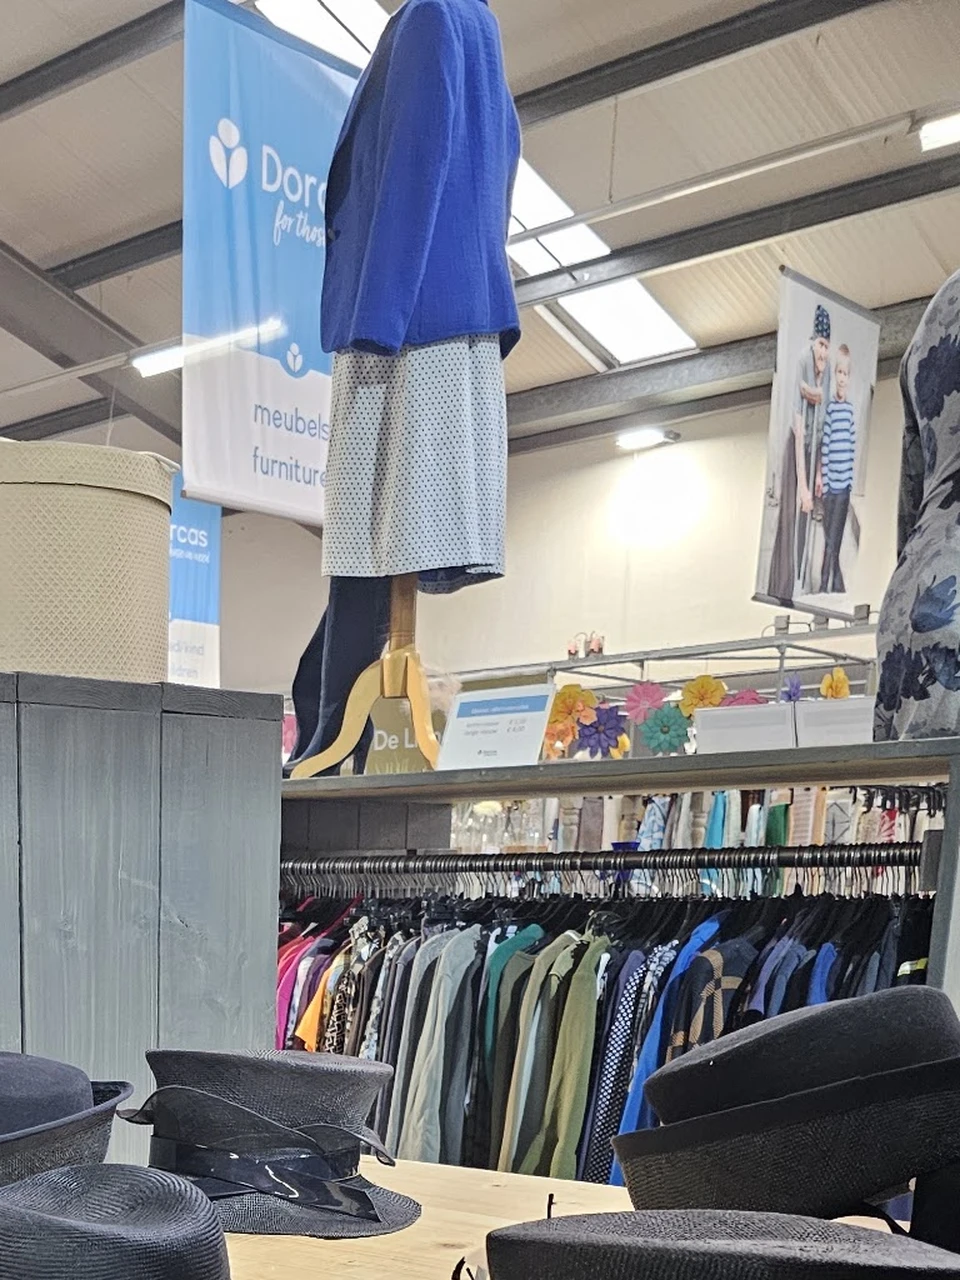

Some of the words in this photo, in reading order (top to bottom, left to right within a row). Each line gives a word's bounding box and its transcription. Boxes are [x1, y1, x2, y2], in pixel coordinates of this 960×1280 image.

[273, 200, 295, 247] for
[253, 403, 330, 442] meubels
[373, 729, 399, 751] De
